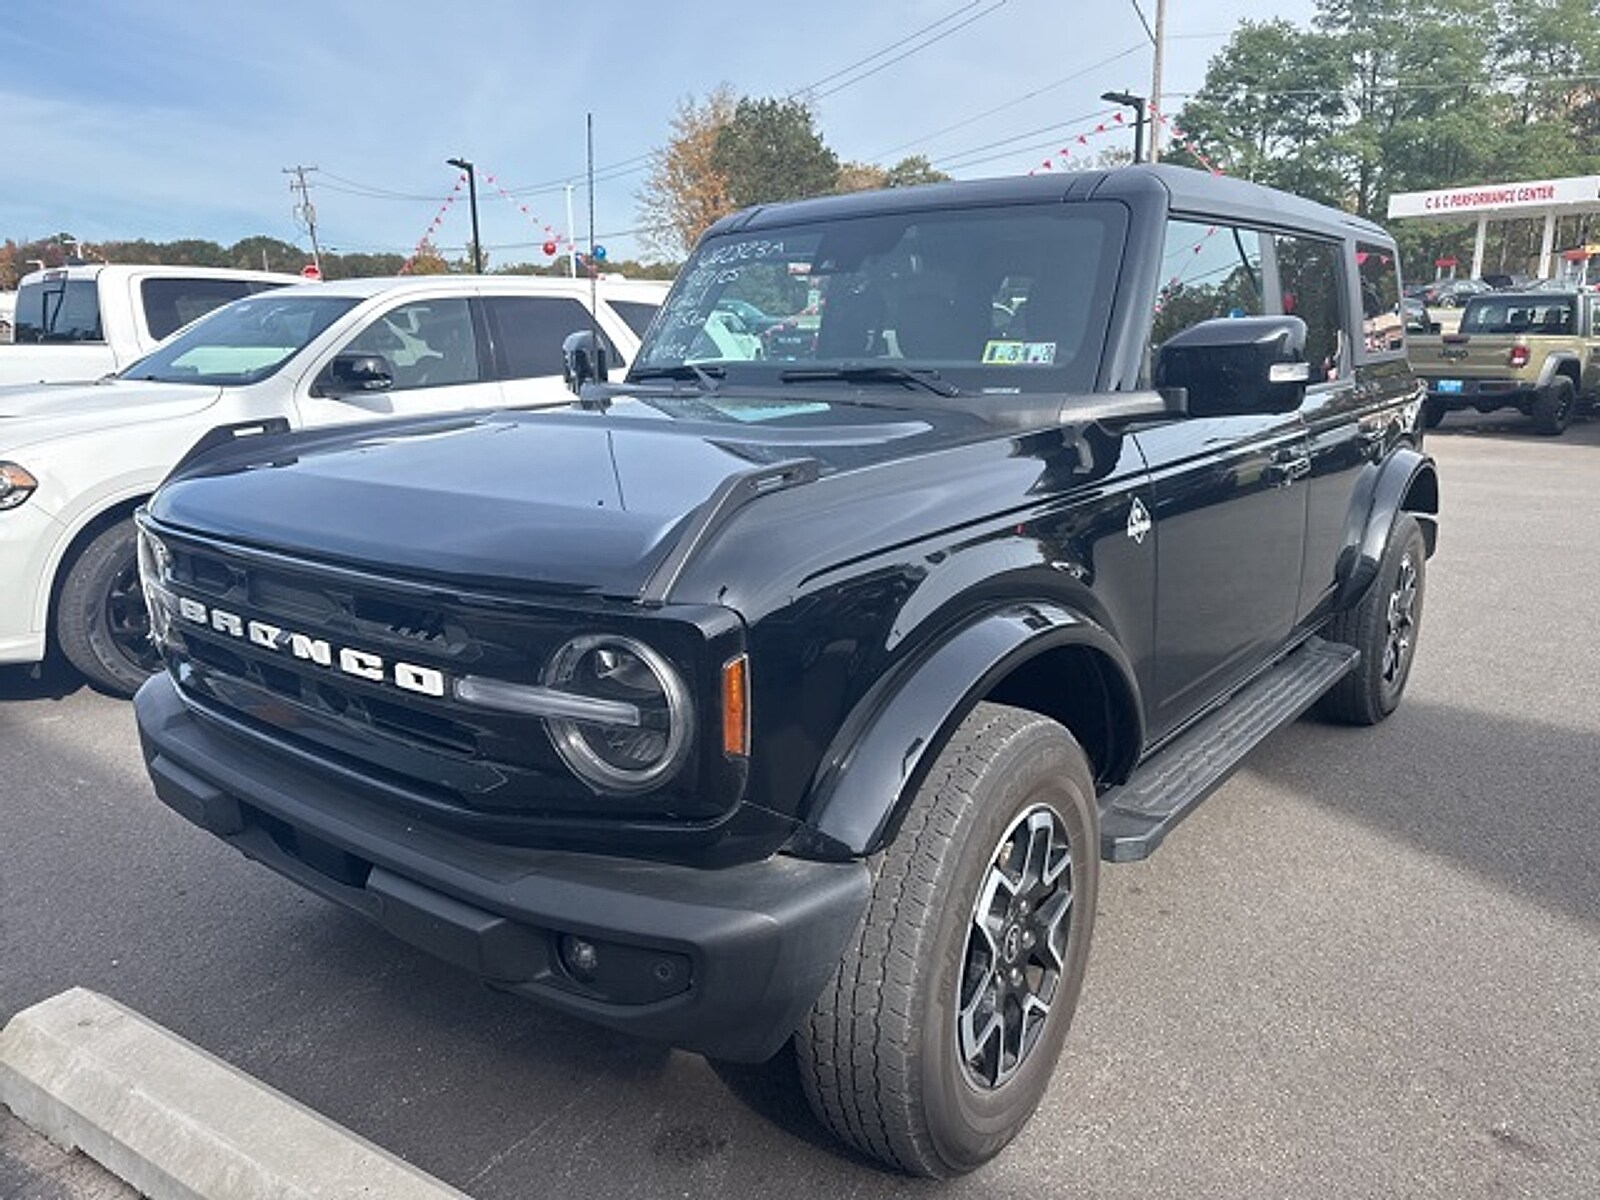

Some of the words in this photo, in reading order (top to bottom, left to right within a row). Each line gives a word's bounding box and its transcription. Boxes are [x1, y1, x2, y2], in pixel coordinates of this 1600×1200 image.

[1425, 196, 1432, 209] C
[1450, 189, 1516, 208] PERFORMANCE
[1517, 186, 1555, 201] CENTER
[180, 597, 444, 696] BRONCO
